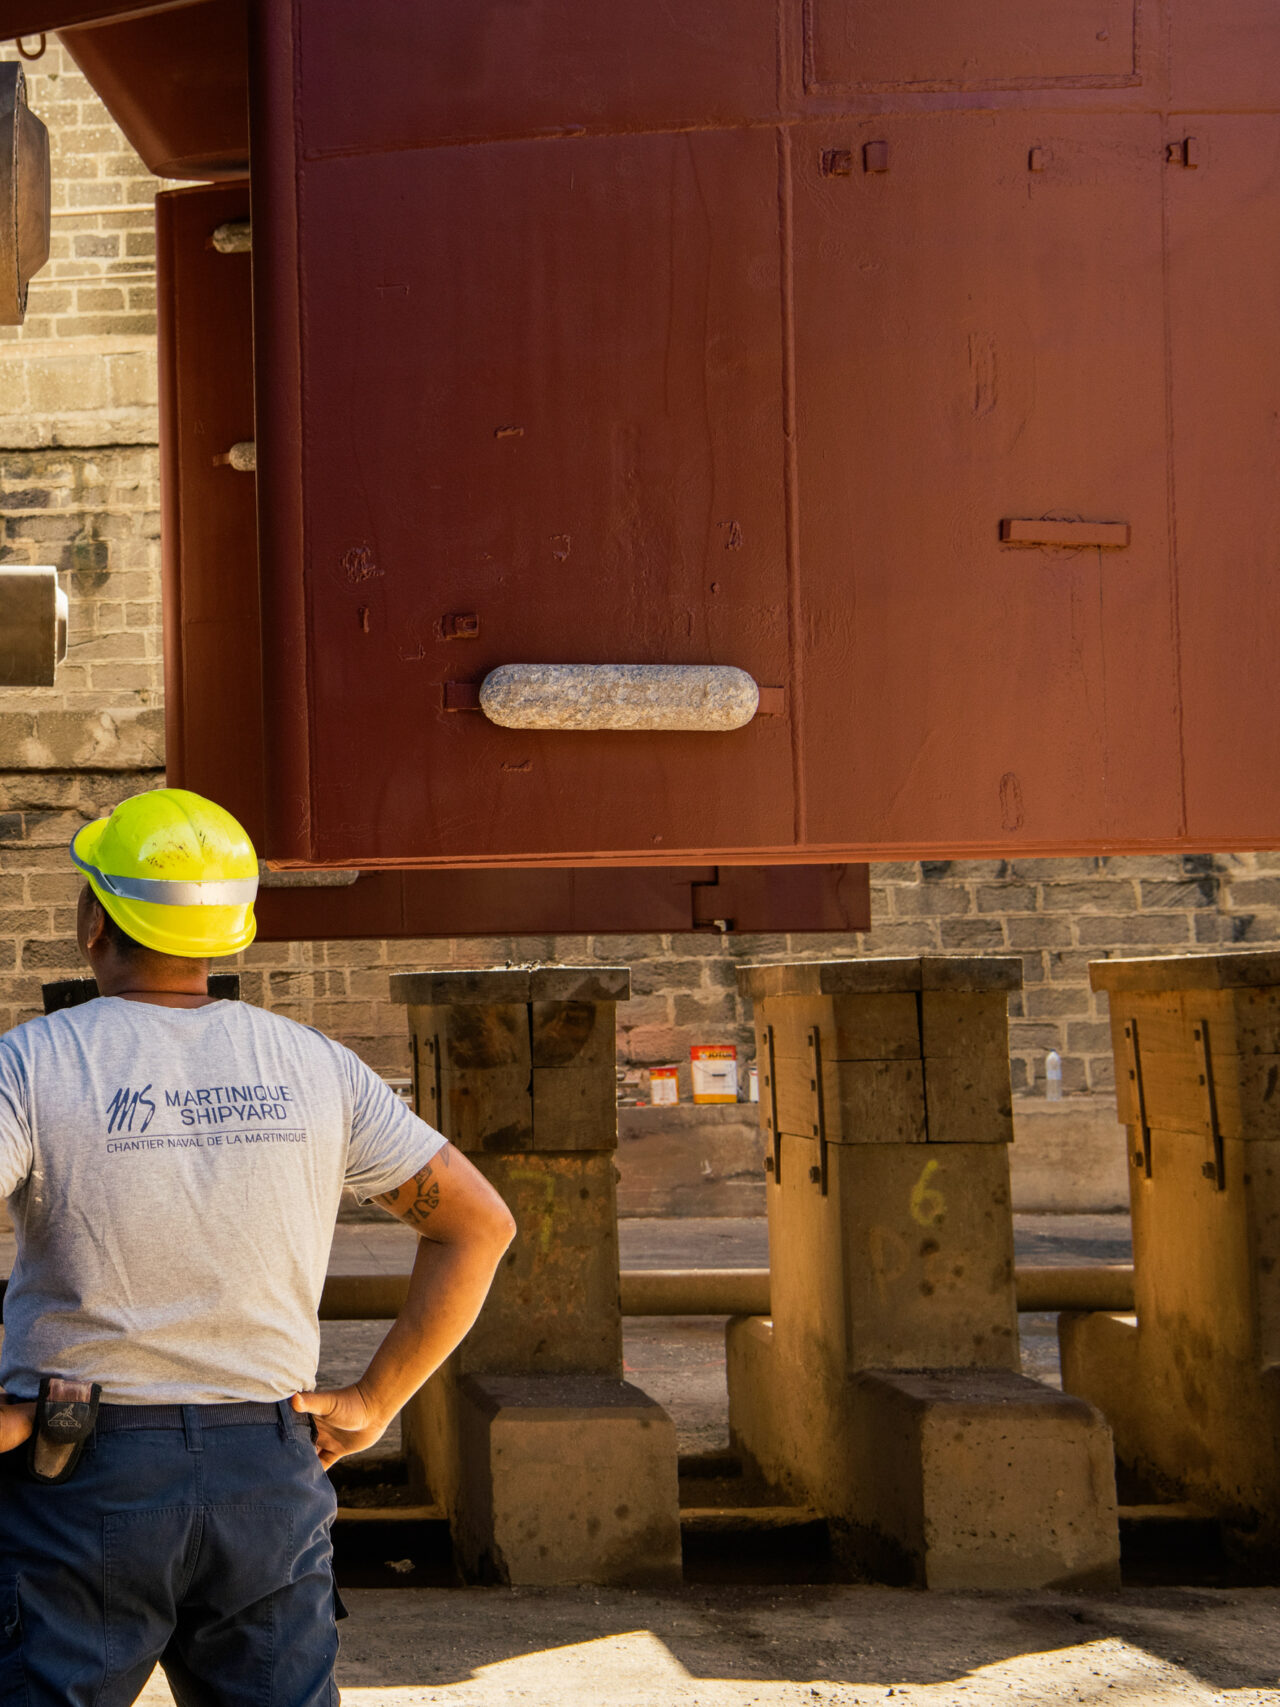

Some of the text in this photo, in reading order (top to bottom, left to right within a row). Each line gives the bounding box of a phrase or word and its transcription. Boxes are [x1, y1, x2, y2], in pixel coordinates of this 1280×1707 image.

[164, 1085, 293, 1107] MARTINIQUE
[106, 1084, 156, 1134] MS
[180, 1103, 287, 1126] SHIPYARD
[106, 1132, 307, 1154] CHANTIER NAVAL DE LA MARTINIQUE
[910, 1159, 946, 1226] 6
